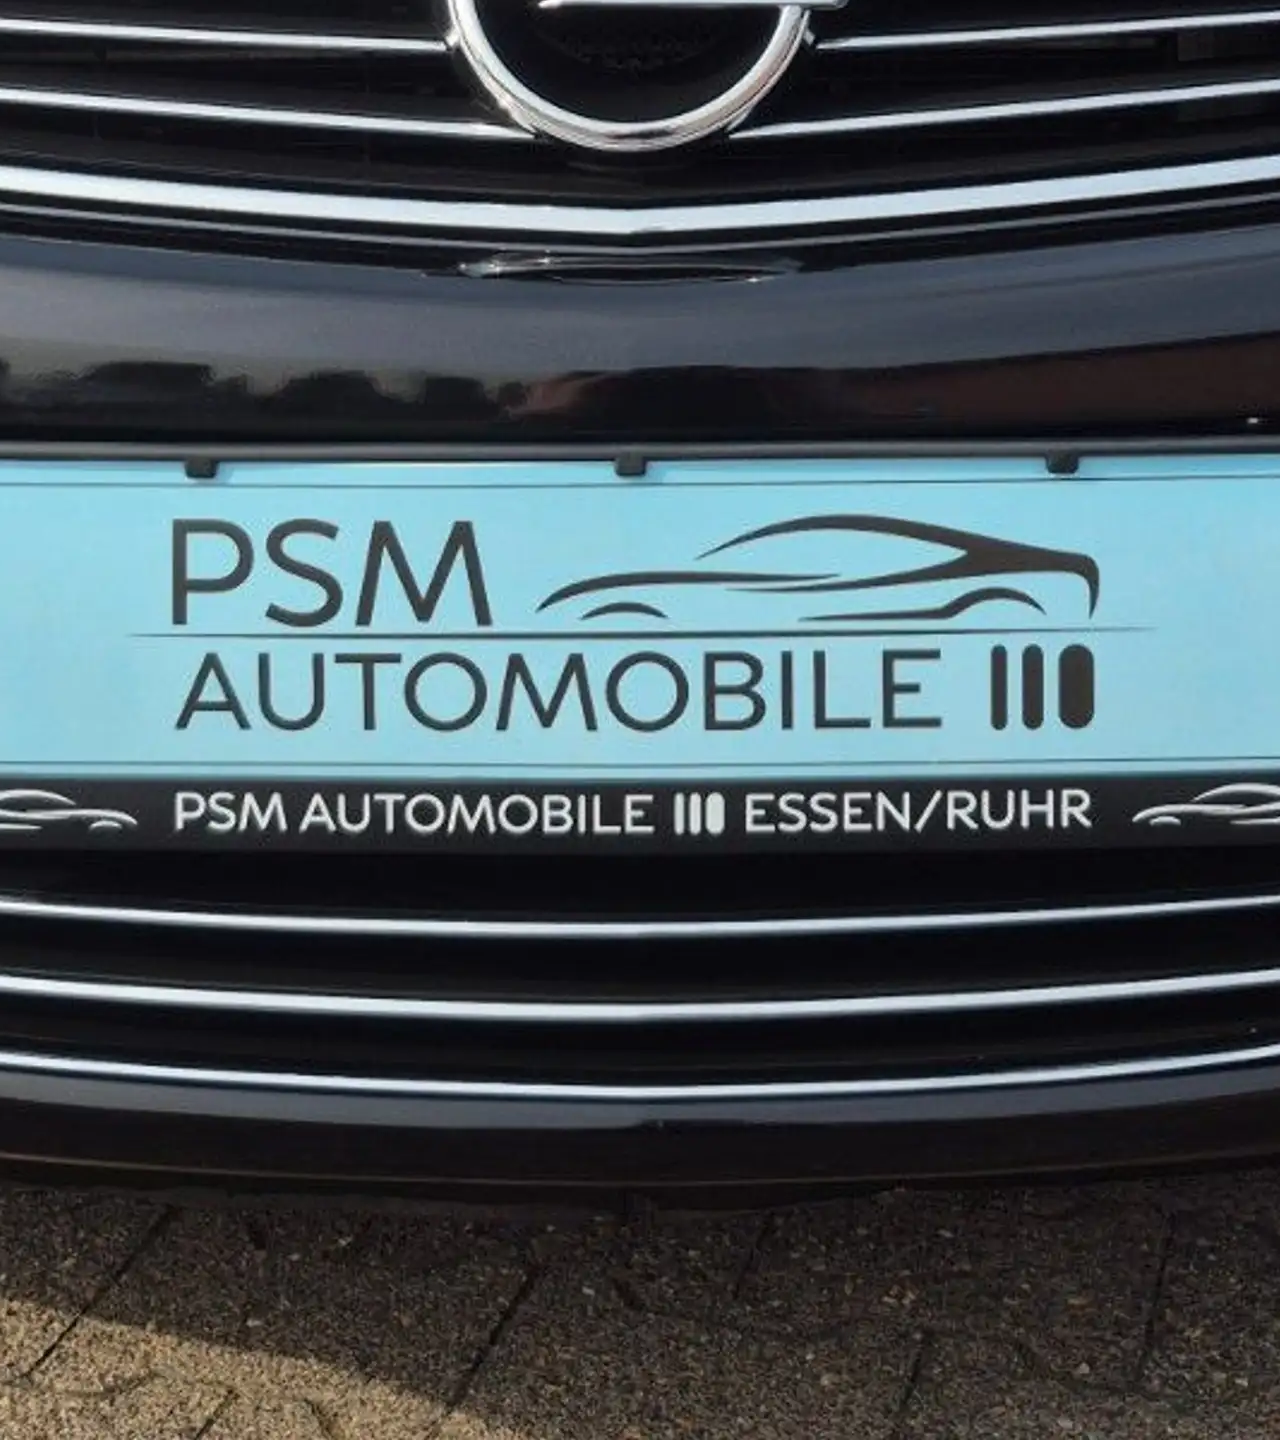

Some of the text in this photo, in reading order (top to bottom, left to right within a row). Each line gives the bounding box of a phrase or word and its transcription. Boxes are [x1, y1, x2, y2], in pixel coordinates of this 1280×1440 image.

[172, 517, 493, 627] PSM
[175, 649, 942, 732] AUTOMOBILE
[174, 788, 1093, 835] PSM AUTOMOBILE ESSEN/RUHR
